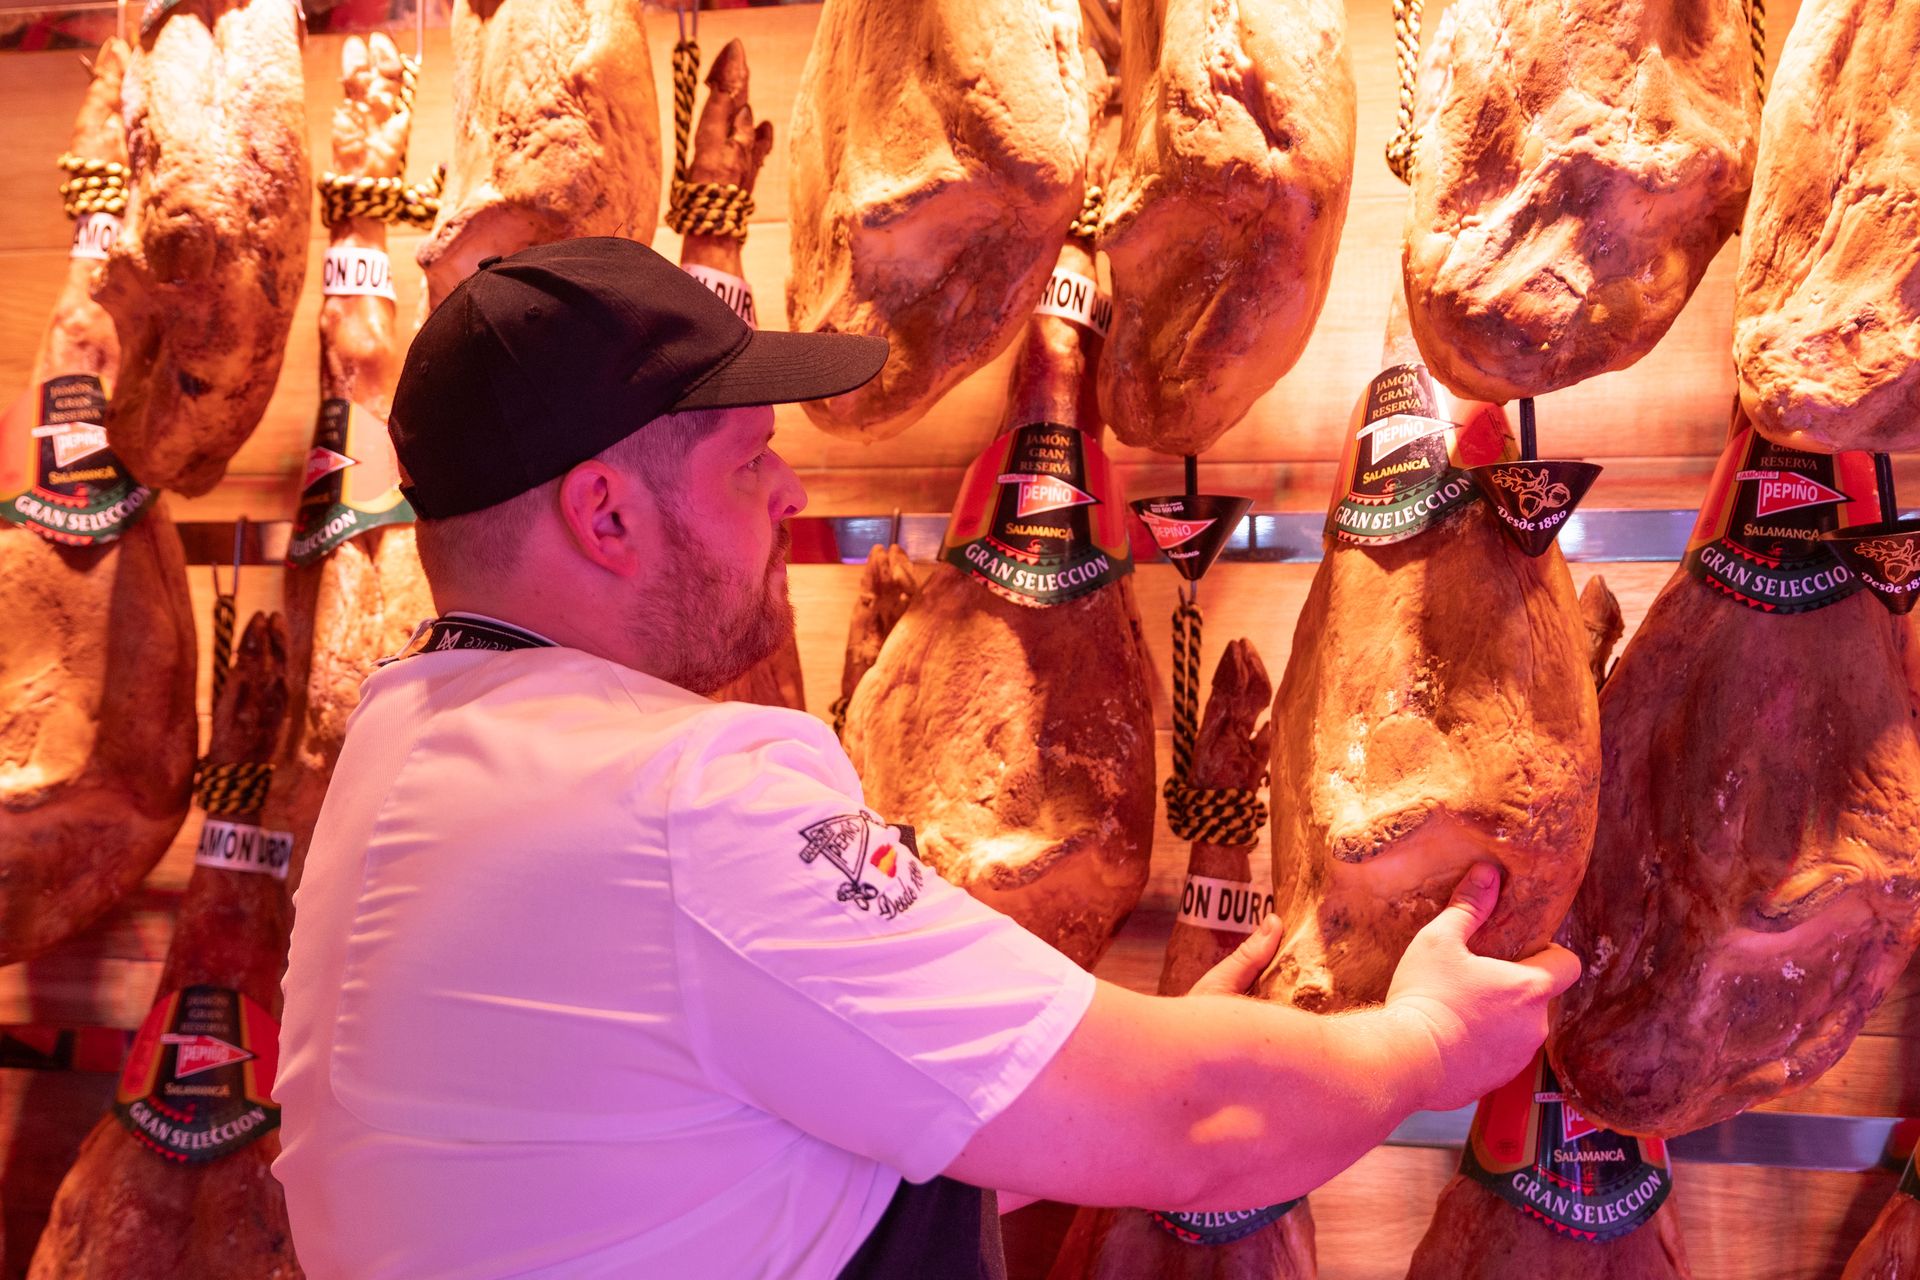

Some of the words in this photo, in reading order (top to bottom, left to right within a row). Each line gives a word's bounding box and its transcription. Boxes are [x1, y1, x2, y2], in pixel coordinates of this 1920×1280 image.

[1379, 387, 1413, 404] GRAN
[1372, 399, 1421, 420] RESERVA
[1030, 448, 1065, 460] GRAN
[1760, 456, 1818, 470] RESERVA
[1020, 462, 1071, 475] RESERVA
[1362, 457, 1430, 485] SALAMANCA
[1334, 506, 1373, 530] GRAN
[1373, 478, 1471, 530] SELECCION
[1762, 479, 1818, 507] PEPIÑO
[1497, 505, 1536, 531] Desde
[1538, 510, 1567, 530] 1880
[1006, 523, 1075, 541] SALAMANCA
[1743, 523, 1820, 541] SALAMANCA
[965, 543, 1014, 581] GRAN
[1012, 554, 1109, 592] SELECCION
[1701, 546, 1752, 586] GRAN
[1751, 566, 1855, 598] SELECCIO
[1861, 572, 1902, 594] Desde
[877, 876, 918, 921] Desde
[1179, 881, 1211, 919] ON
[1218, 887, 1275, 926] DURO
[130, 1102, 172, 1141] GRAN
[170, 1107, 266, 1149] SELECCION
[1554, 1148, 1626, 1163] SALAMANCA
[1512, 1172, 1569, 1216] GRAN
[1571, 1170, 1662, 1225] SELECCION
